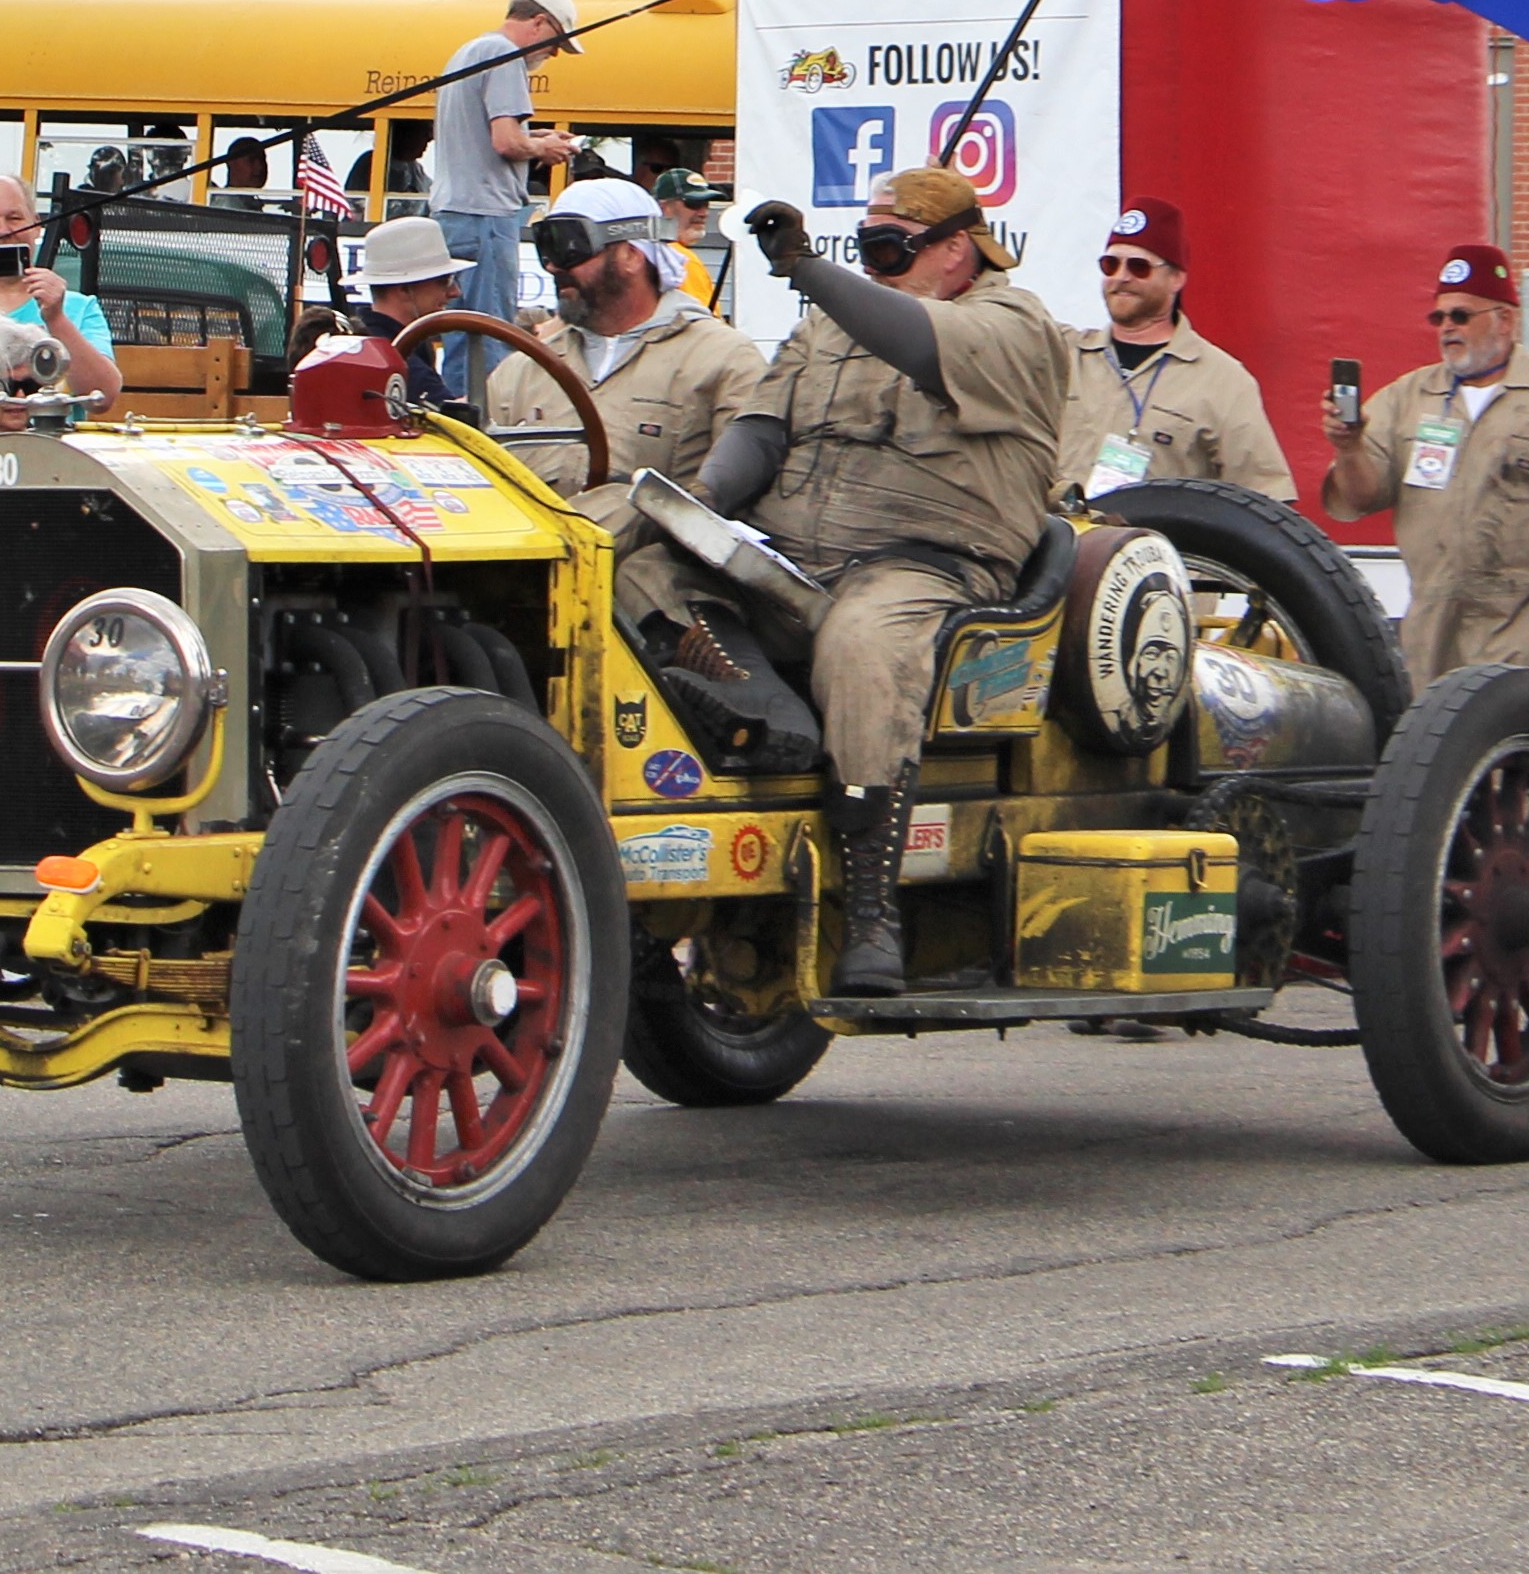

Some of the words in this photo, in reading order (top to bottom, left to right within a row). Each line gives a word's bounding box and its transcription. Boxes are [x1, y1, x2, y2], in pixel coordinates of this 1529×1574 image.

[868, 42, 980, 86] FOLLOW
[991, 40, 1041, 83] US!
[89, 615, 125, 648] 30
[1098, 571, 1129, 679] WANDERING
[1205, 657, 1258, 704] 30
[624, 867, 646, 881] uto
